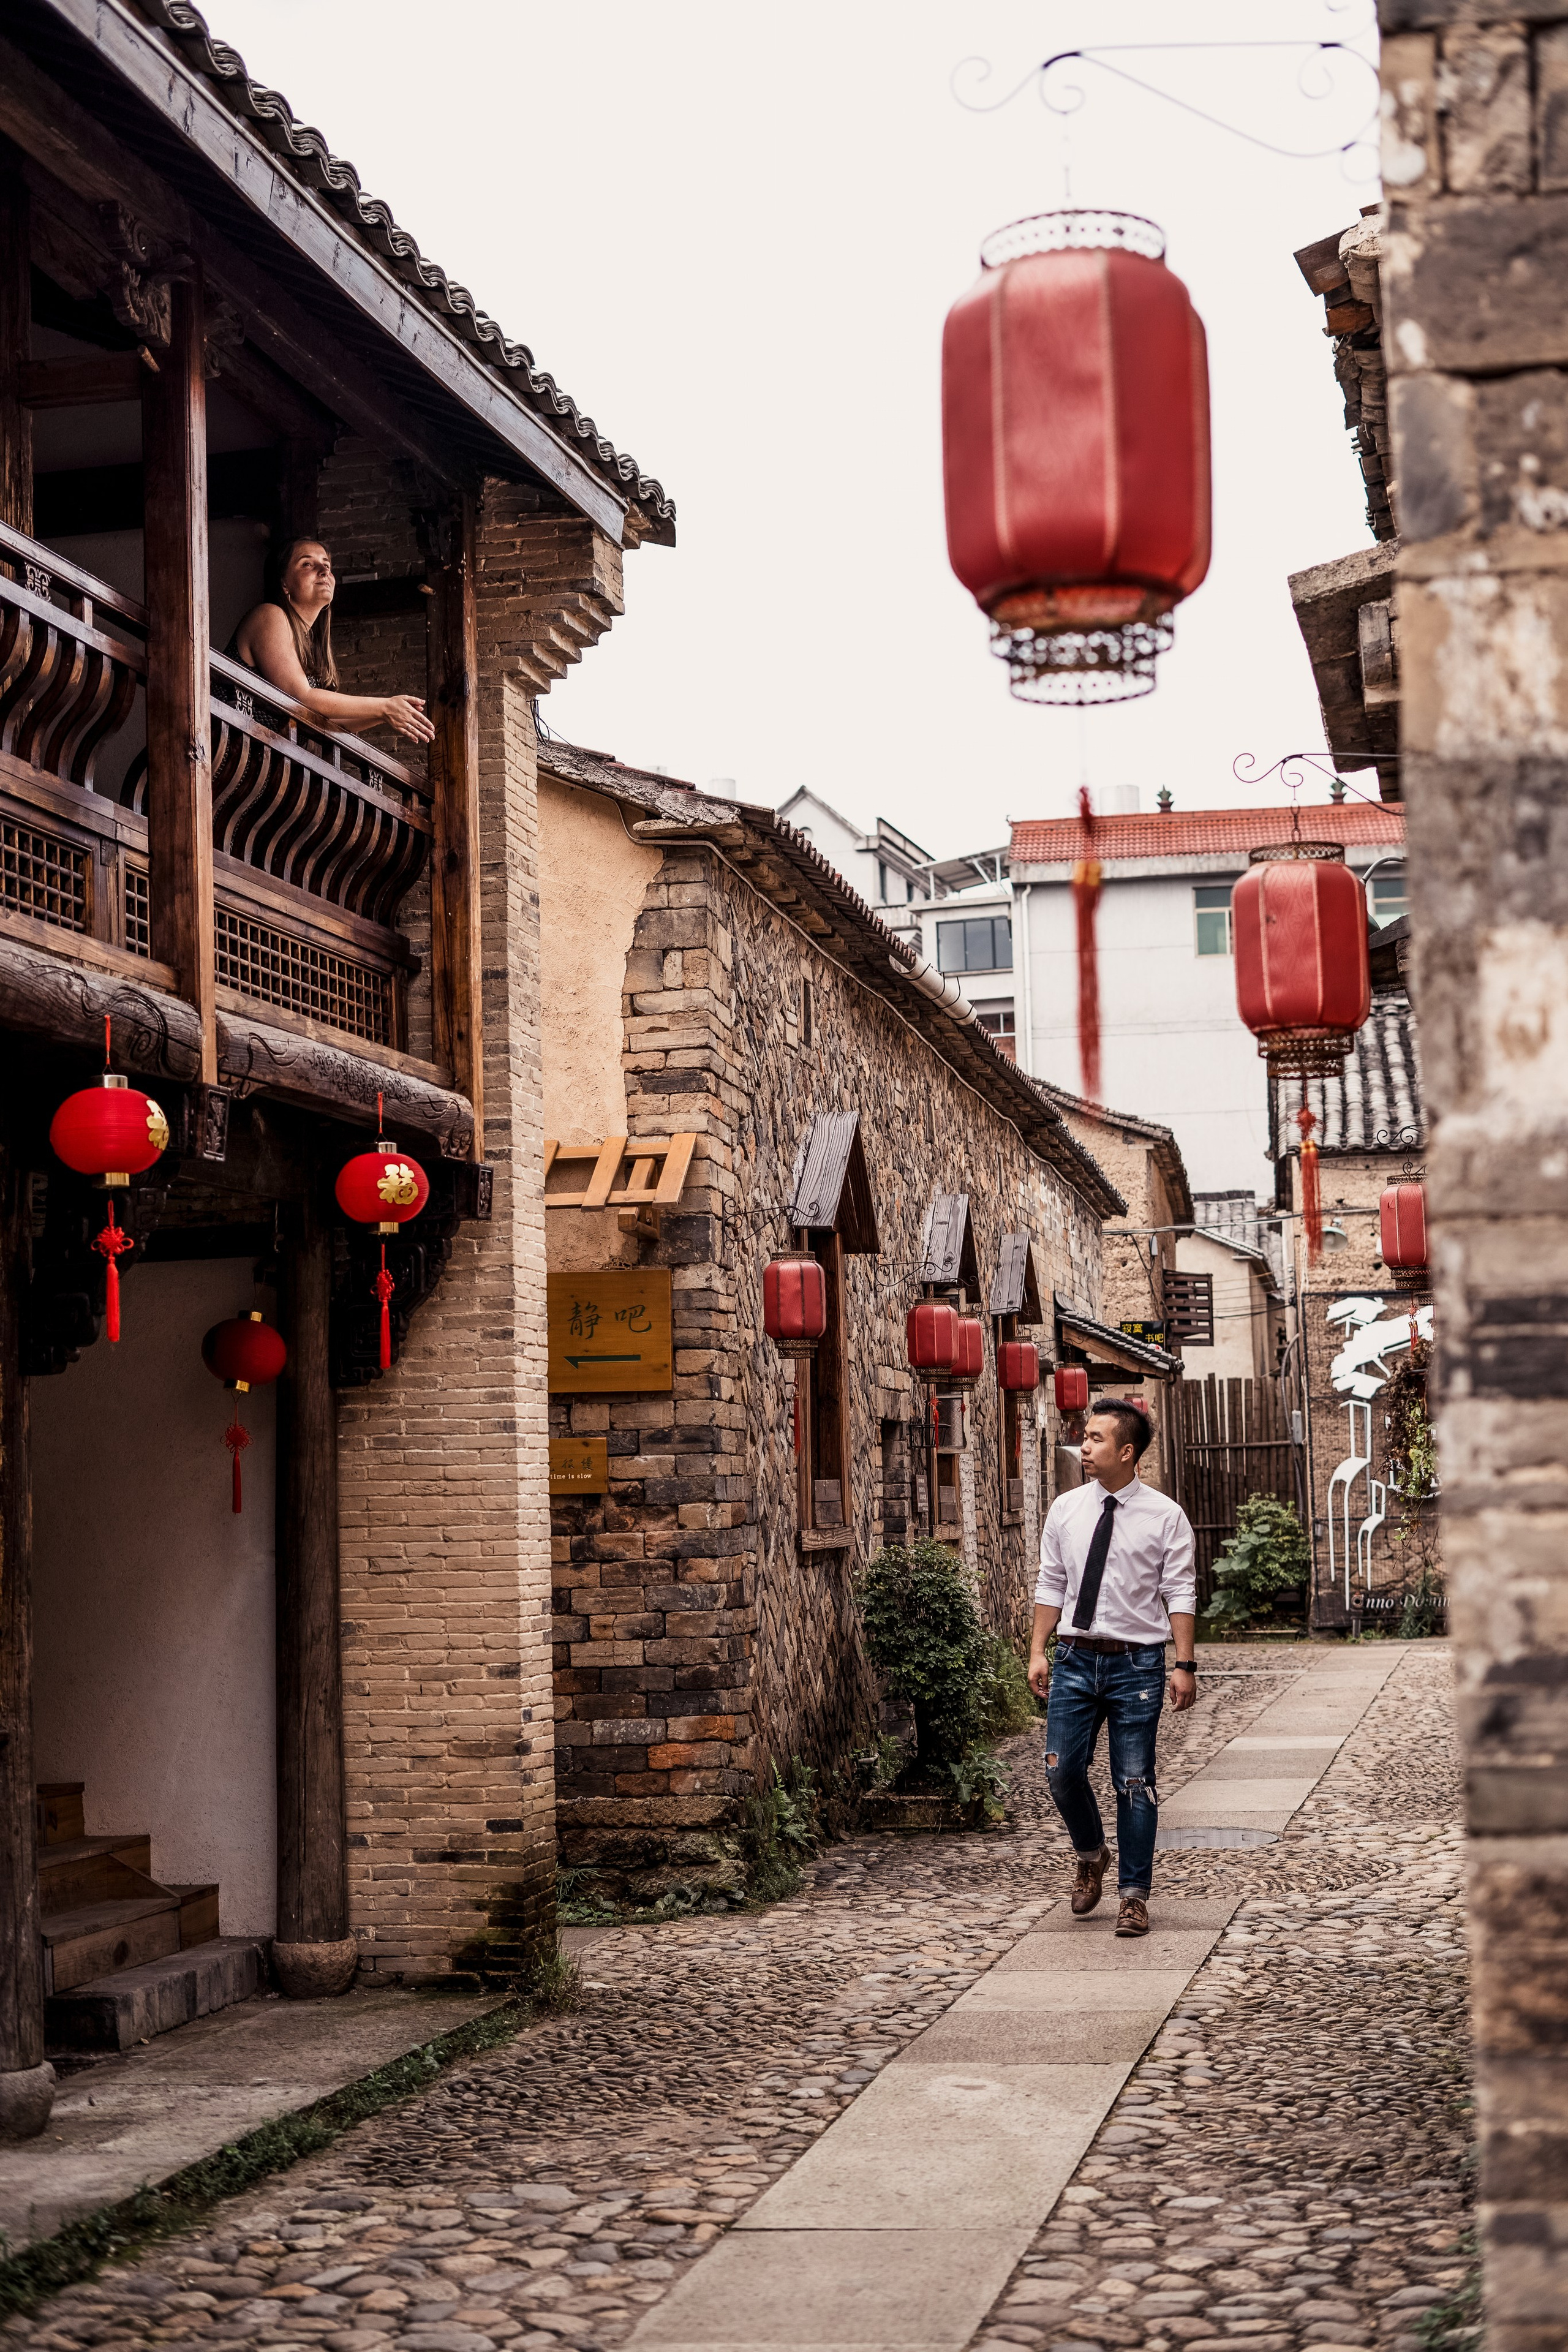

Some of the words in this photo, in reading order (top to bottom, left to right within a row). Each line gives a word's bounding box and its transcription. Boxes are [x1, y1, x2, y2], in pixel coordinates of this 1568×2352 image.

[377, 1163, 419, 1205] 福
[547, 1301, 652, 1340] 静吧
[1121, 1323, 1144, 1333] 寂寞
[1145, 1333, 1164, 1343] 书吧
